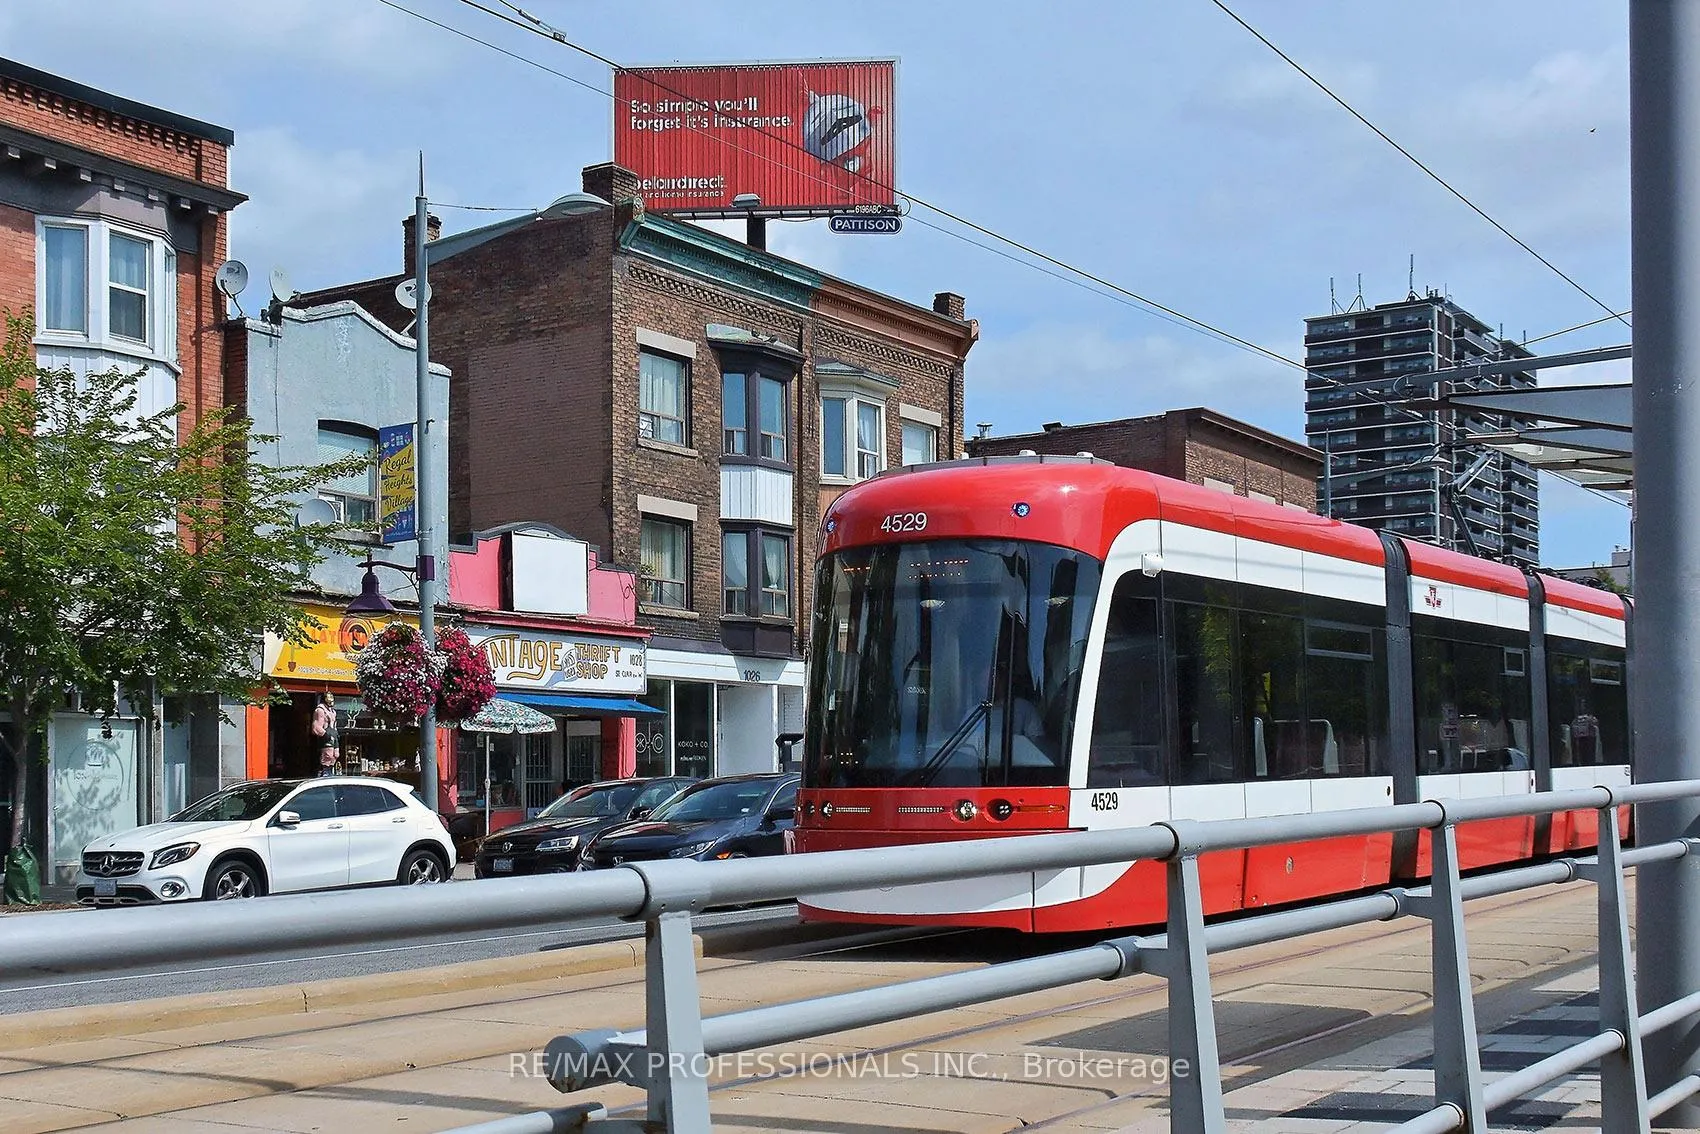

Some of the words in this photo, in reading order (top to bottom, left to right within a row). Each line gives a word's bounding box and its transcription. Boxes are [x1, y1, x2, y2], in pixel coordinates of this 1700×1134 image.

[656, 98, 709, 115] simple
[631, 116, 681, 131] forget
[687, 114, 709, 128] it's
[835, 219, 896, 231] PATTISON
[384, 449, 412, 475] Regal
[384, 475, 413, 492] Heights
[385, 494, 414, 512] Village
[880, 512, 928, 533] 4529
[574, 643, 621, 663] THRIFT
[629, 654, 643, 667] 1028
[576, 661, 609, 680] SHOP
[743, 670, 761, 682] 1026
[678, 740, 694, 748] KOKO
[1091, 791, 1119, 811] 4529
